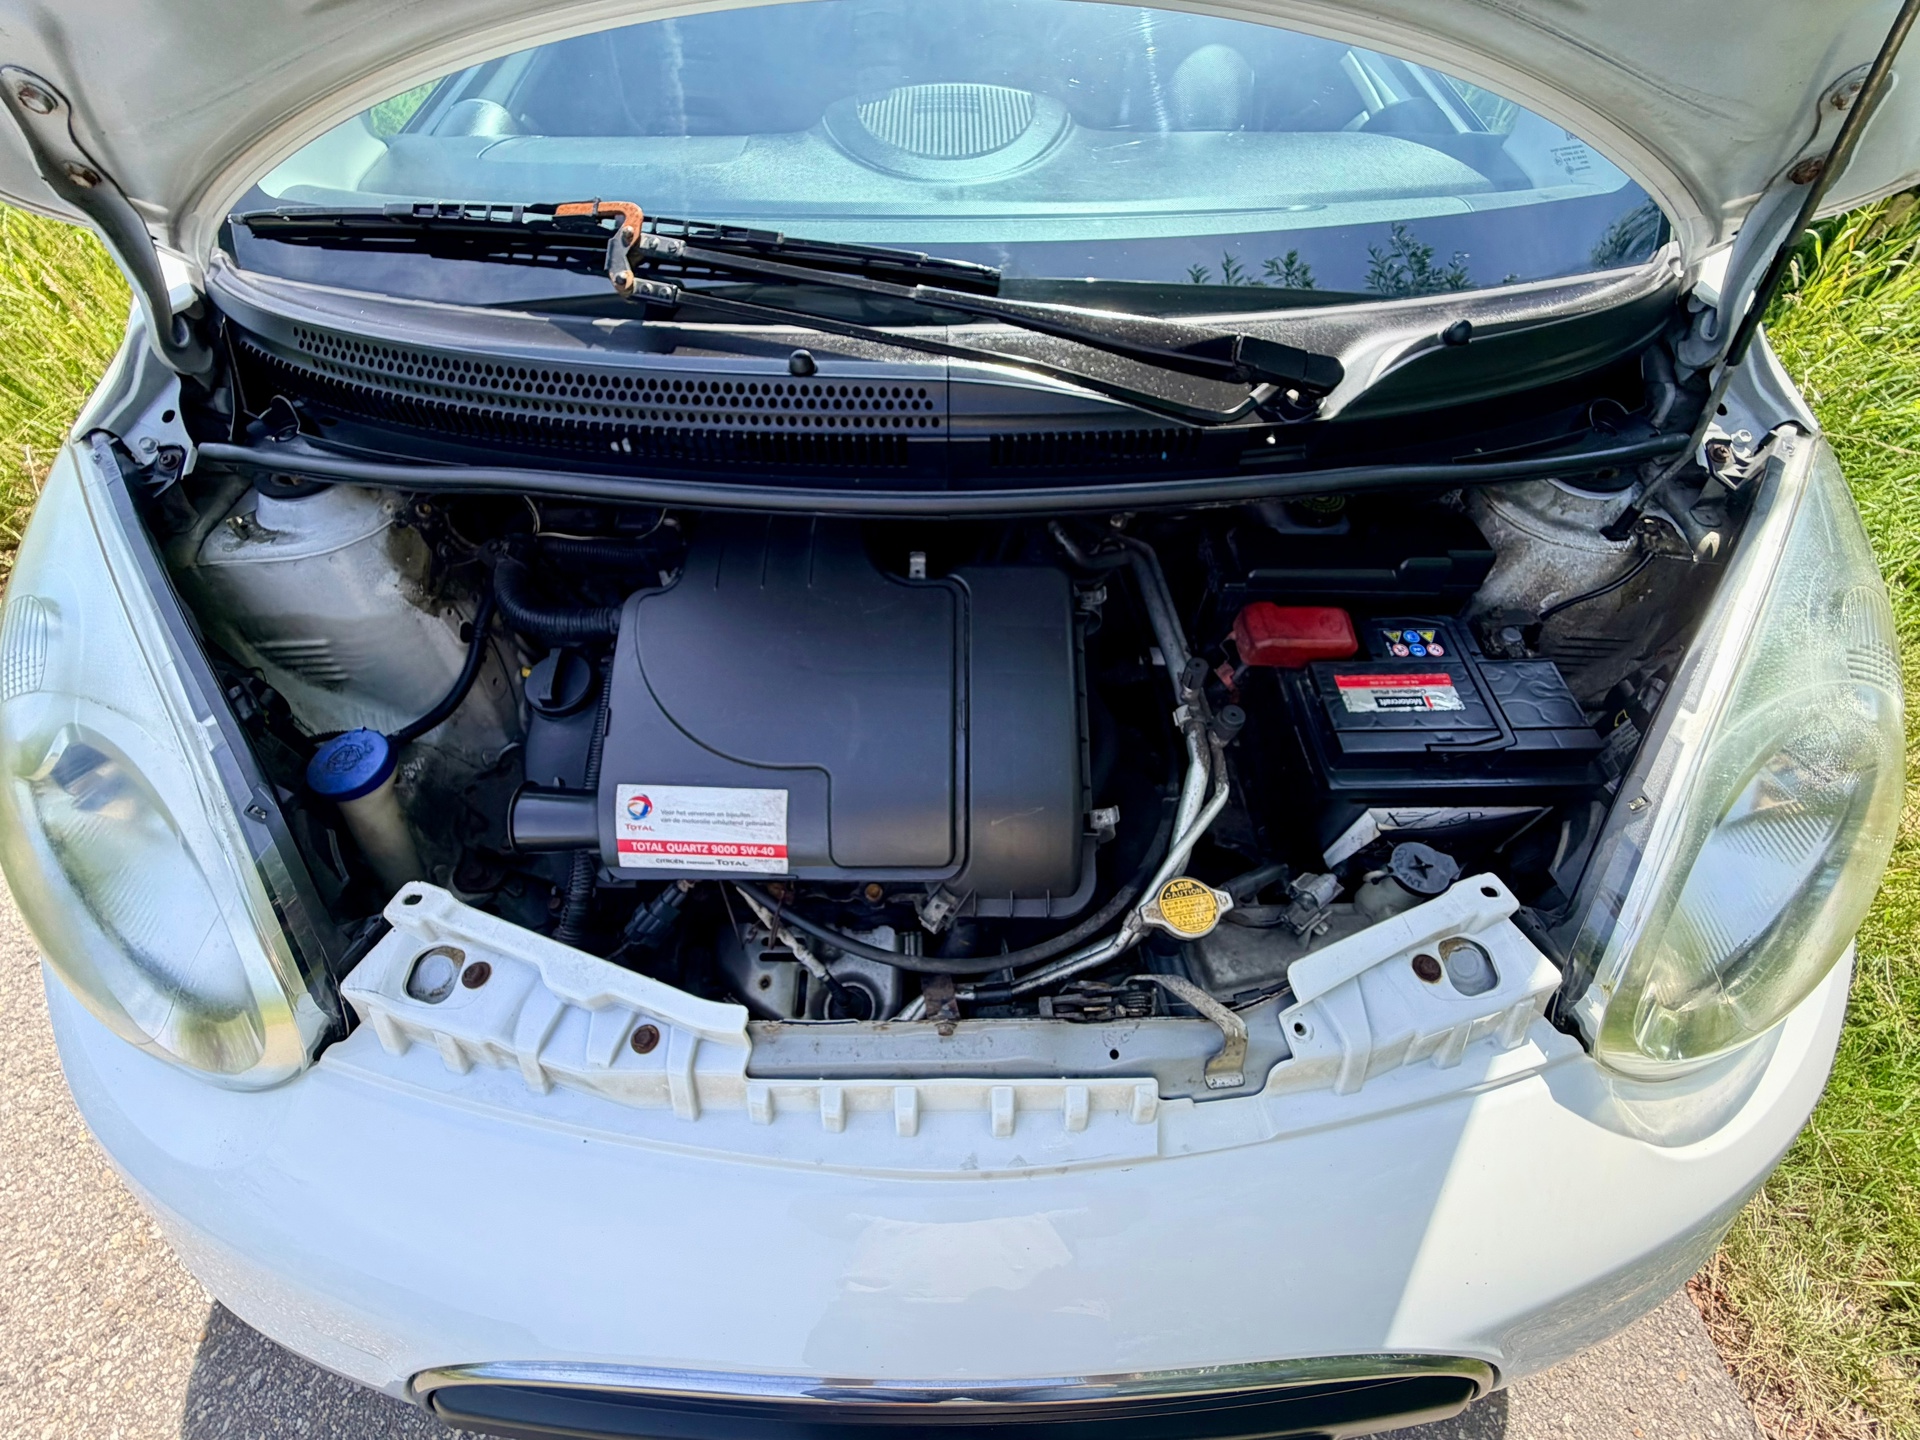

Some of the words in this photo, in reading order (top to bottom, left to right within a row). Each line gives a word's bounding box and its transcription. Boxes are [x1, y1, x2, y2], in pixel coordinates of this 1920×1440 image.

[1378, 697, 1424, 706] Motorcraft
[676, 809, 686, 817] het
[625, 823, 655, 831] TOTAL
[631, 841, 664, 852] TOTAL
[666, 842, 709, 854] QUARTZ
[711, 844, 738, 855] 9000
[740, 845, 775, 856] 5W-40
[715, 858, 749, 867] TOTAL
[1394, 847, 1423, 888] COOLANT
[1165, 887, 1203, 899] CAUTION
